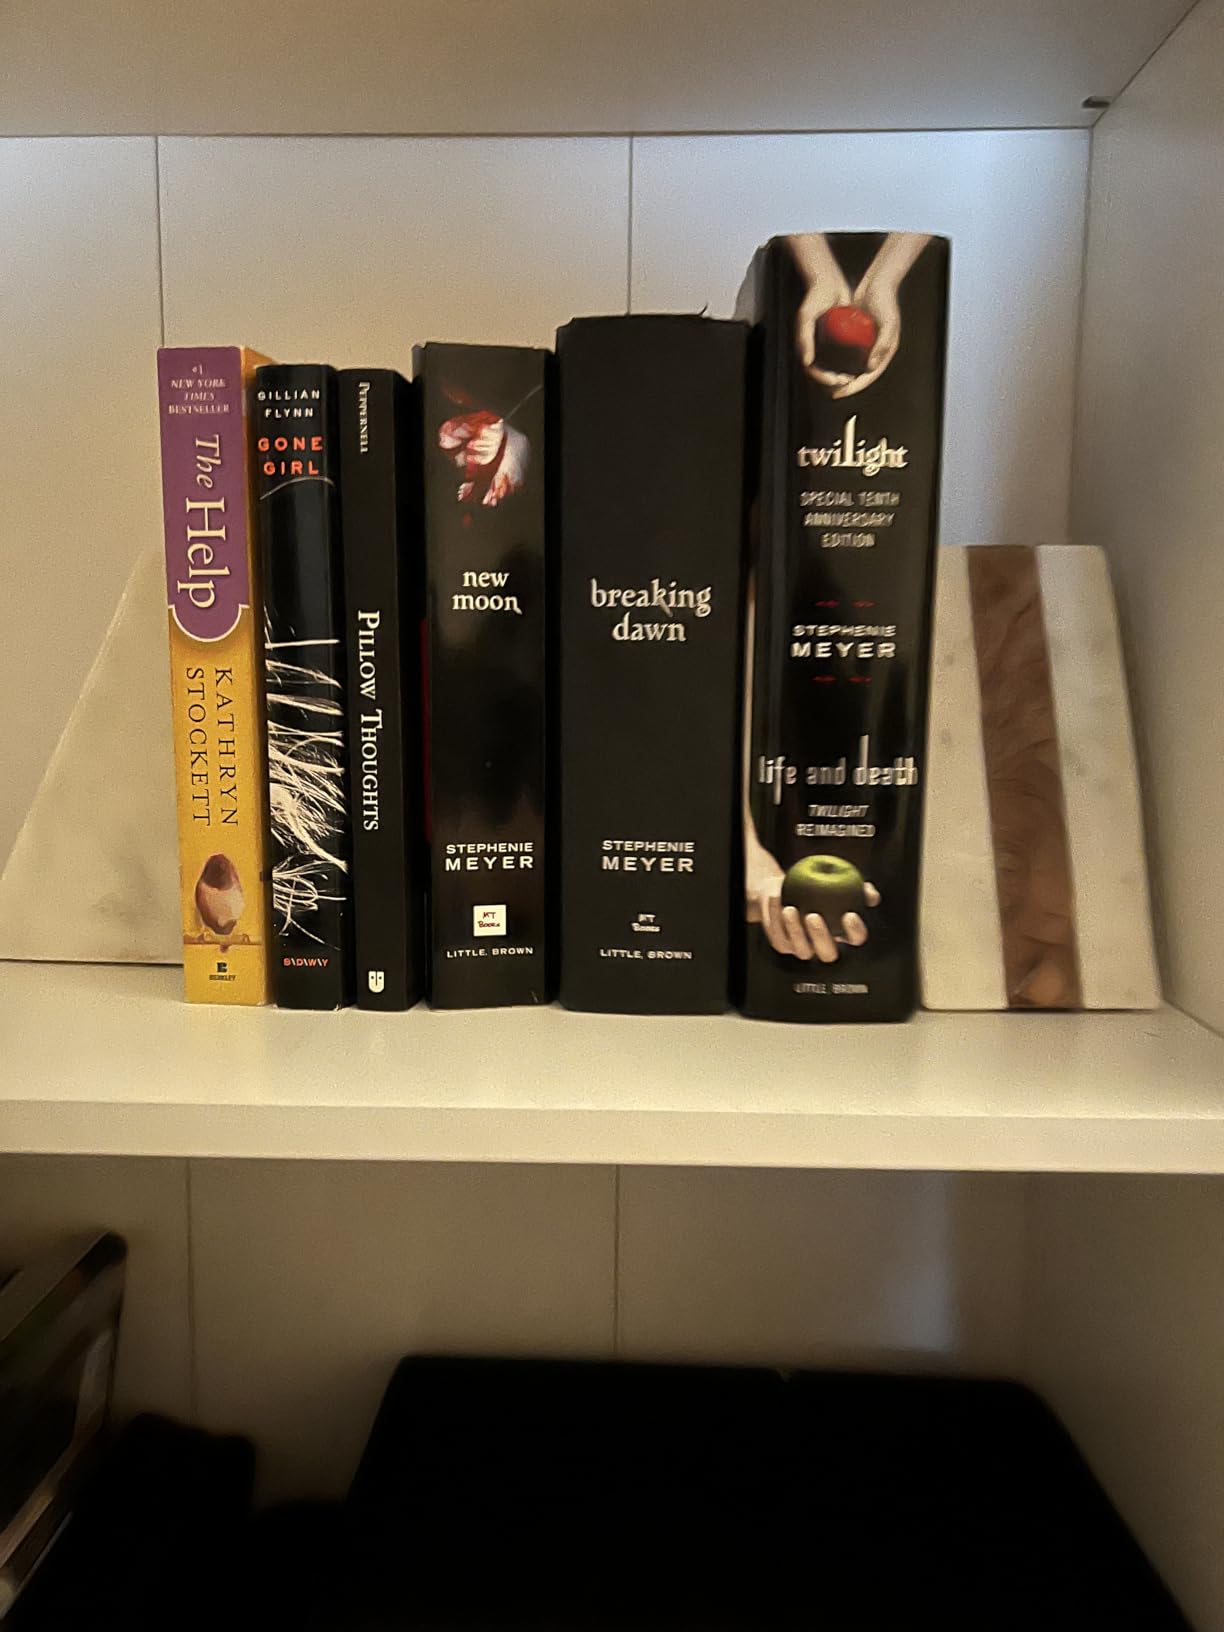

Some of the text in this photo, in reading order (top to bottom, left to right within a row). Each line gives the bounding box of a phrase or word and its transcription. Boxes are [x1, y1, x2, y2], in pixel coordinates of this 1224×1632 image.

[170, 378, 226, 389] NEW YORK
[257, 389, 321, 401] GILLIAN
[168, 403, 230, 415] BESTSELLER
[264, 407, 314, 419] FLYNN
[257, 436, 324, 452] GONE
[797, 414, 909, 477] twilight
[263, 460, 320, 475] GIRL
[800, 491, 901, 507] SPECIAL TENTH
[177, 434, 231, 608] The Help
[804, 511, 896, 528] ANNIVERSARY
[820, 532, 876, 548] EDITION
[462, 570, 510, 588] new
[452, 593, 523, 615] moon
[590, 578, 712, 618] breaking
[612, 611, 686, 642] dawn
[792, 624, 897, 637] STEPHENIE
[791, 641, 897, 659] MEYER
[357, 610, 383, 831] PILLOW THOUGHTS
[186, 667, 211, 826] STOCKETT
[214, 667, 239, 826] KATHRYN
[757, 734, 918, 806] life and death
[807, 804, 870, 818] TWILIGHT
[796, 823, 876, 838] REIMAGINED
[446, 842, 535, 854] STEPHENIE
[602, 840, 696, 853] STEPHENIE
[445, 856, 535, 871] MEYER
[602, 855, 695, 873] MEYER
[491, 946, 535, 956] BROWN
[647, 950, 694, 960] BROWN
